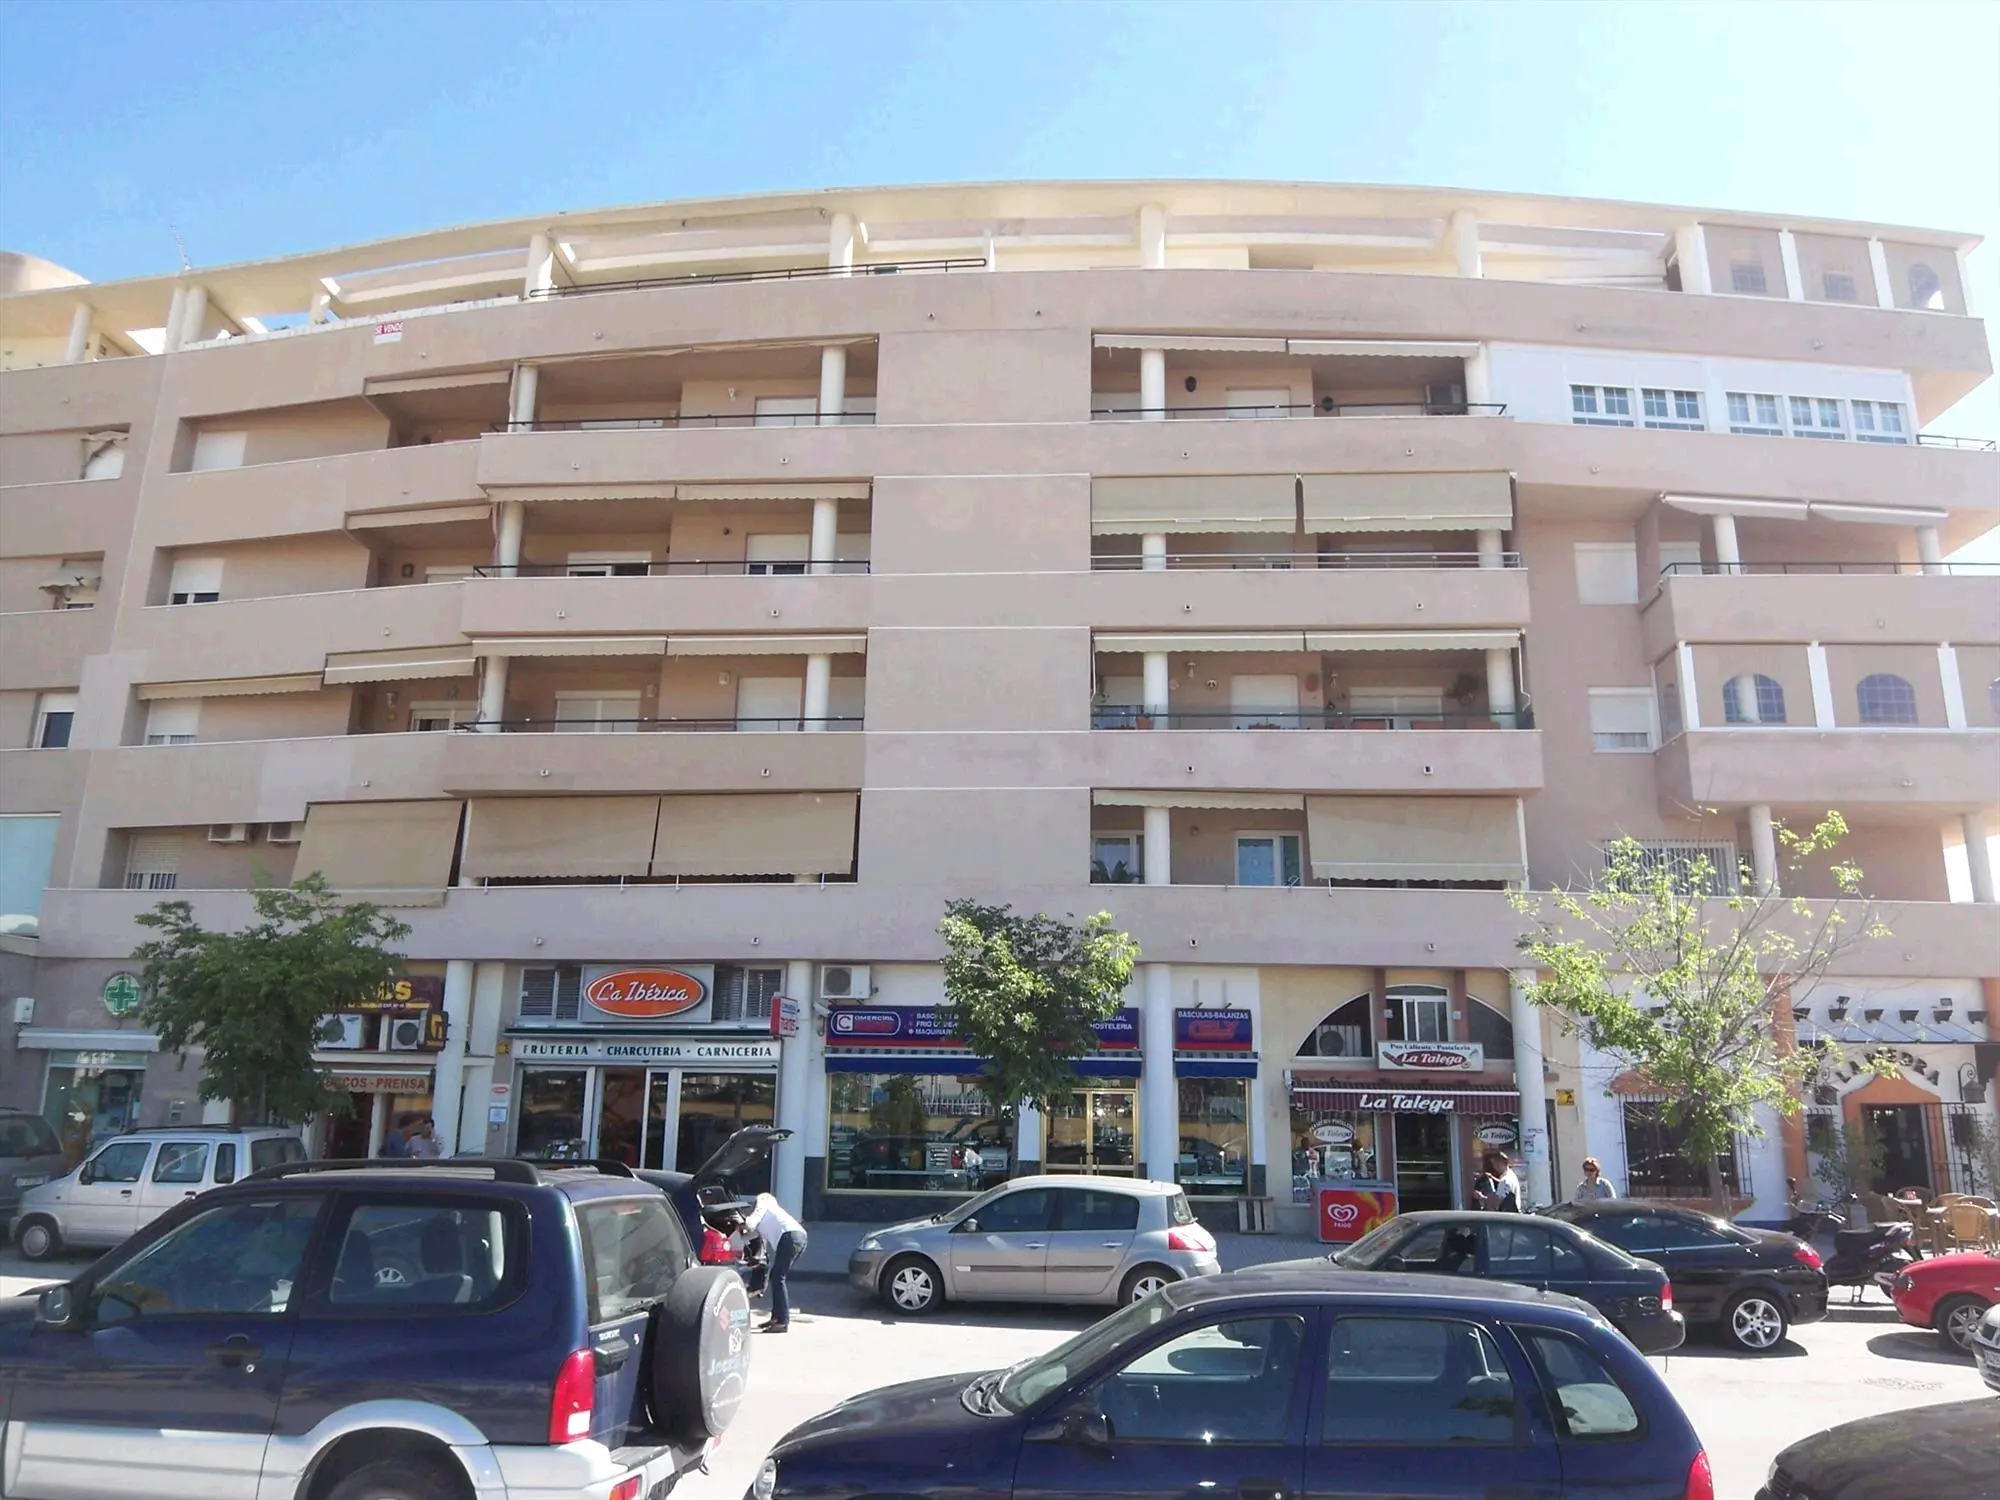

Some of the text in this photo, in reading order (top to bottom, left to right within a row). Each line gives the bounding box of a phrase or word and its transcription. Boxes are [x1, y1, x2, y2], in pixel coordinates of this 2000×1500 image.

[596, 981, 688, 1001] La Ibérica
[523, 1044, 773, 1058] FRUTERIA CHARCUTERIA CARNICERIA
[1401, 1053, 1464, 1066] La Talega
[376, 1078, 426, 1090] PRENSA
[1360, 1094, 1455, 1115] La Talega
